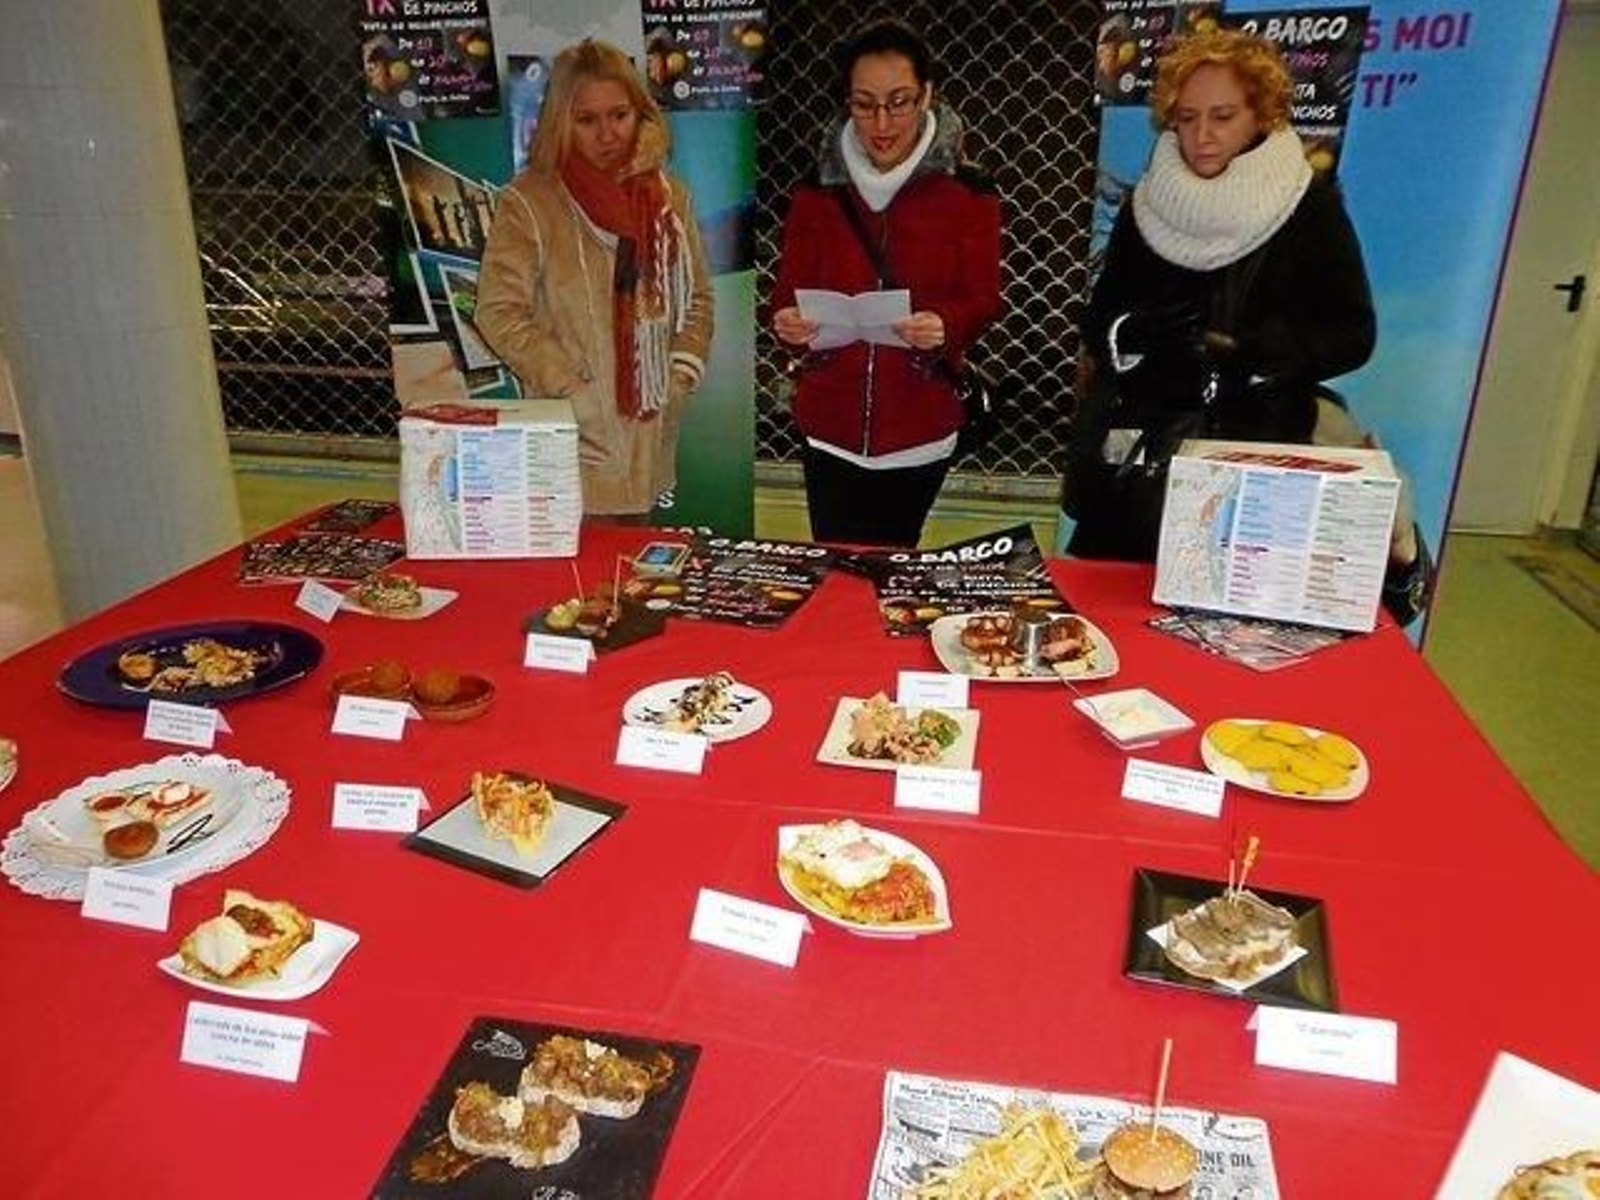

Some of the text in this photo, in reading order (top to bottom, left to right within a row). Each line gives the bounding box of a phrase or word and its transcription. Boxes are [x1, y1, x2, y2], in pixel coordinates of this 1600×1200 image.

[1265, 16, 1348, 44] BARCO
[1291, 105, 1338, 120] NCHOS
[734, 540, 828, 558] BARCO
[889, 536, 1014, 564] O BARCO
